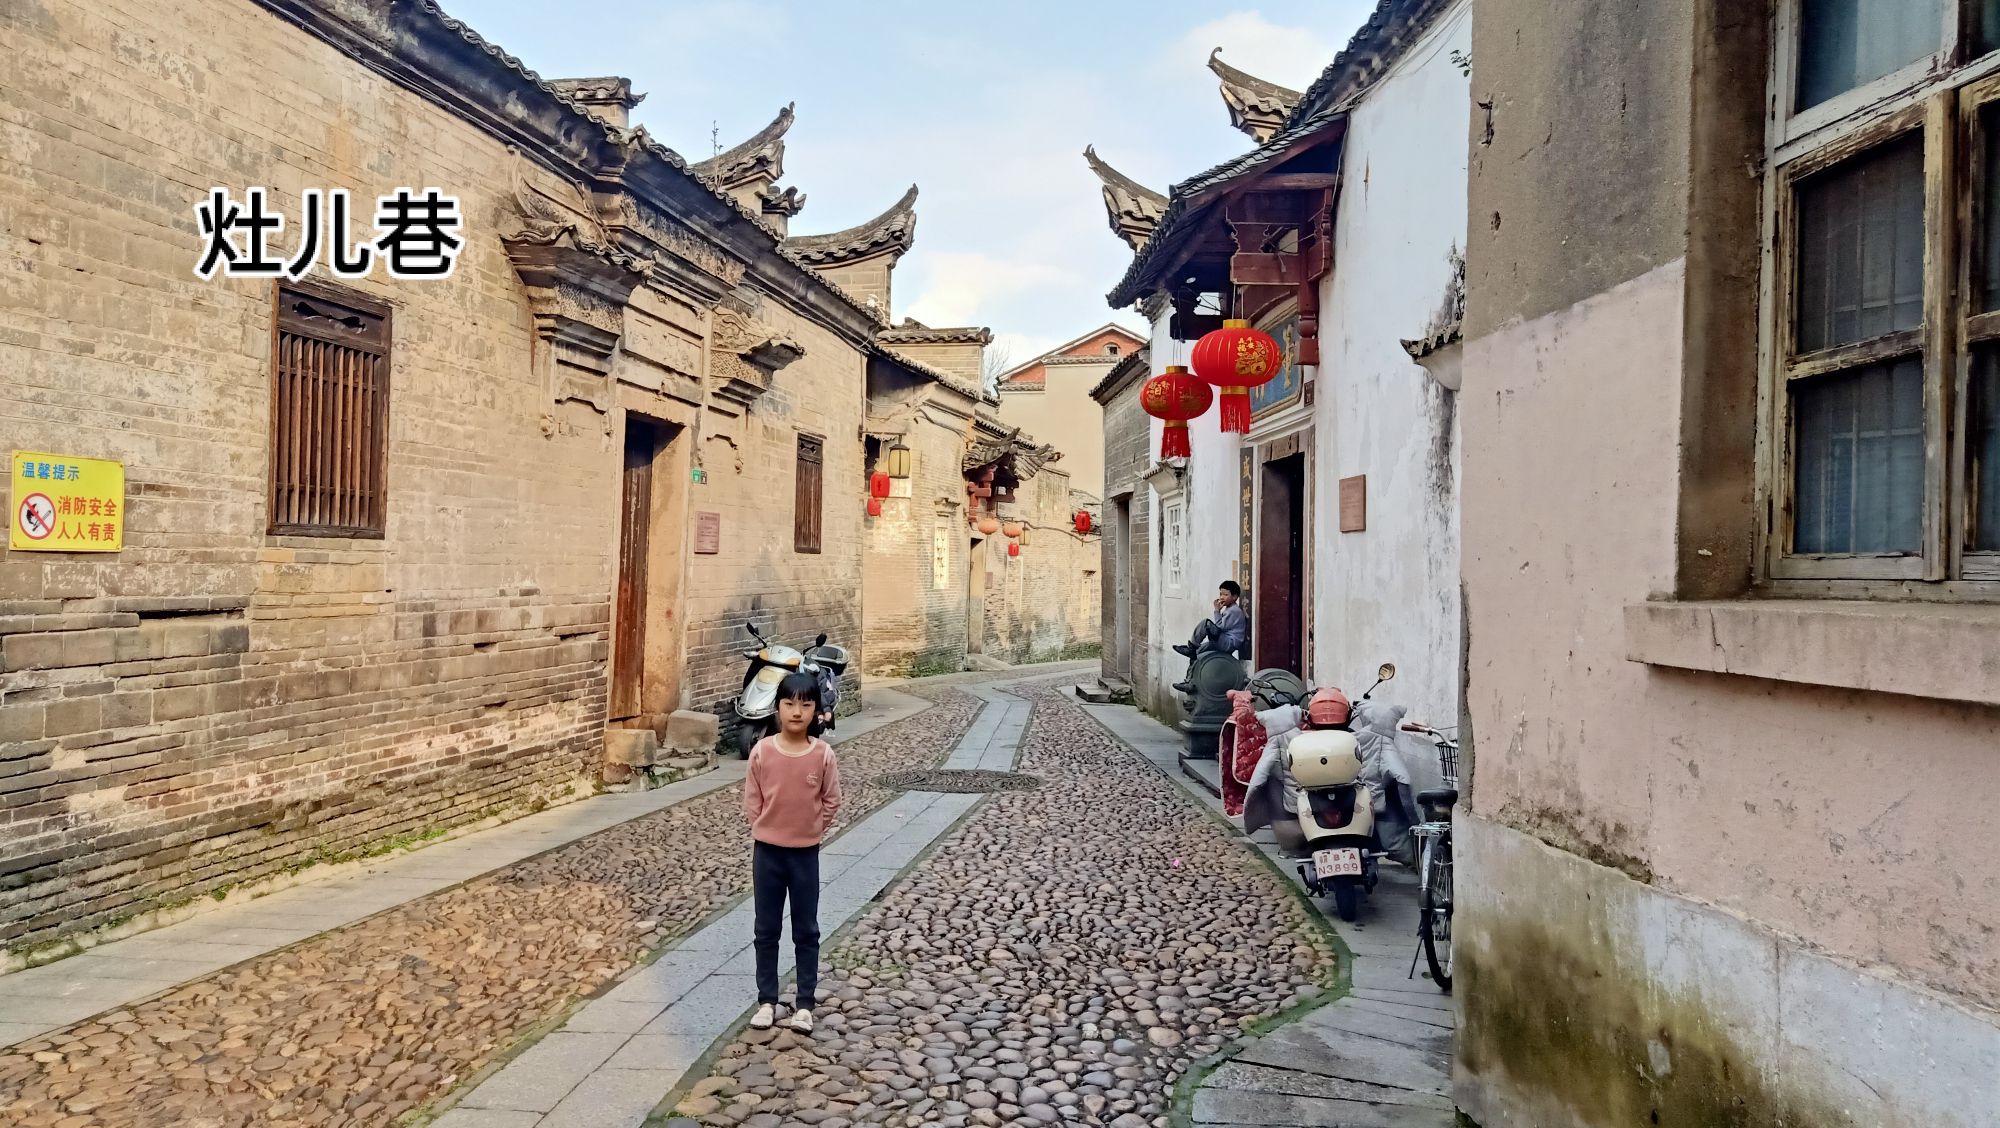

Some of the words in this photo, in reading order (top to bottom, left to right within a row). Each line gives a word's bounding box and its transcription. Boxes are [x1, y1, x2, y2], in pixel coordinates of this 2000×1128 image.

[22, 462, 80, 481] 温馨提示
[58, 496, 117, 517] 消防安全
[57, 522, 116, 541] 人人有责
[1318, 862, 1358, 874] N3899
